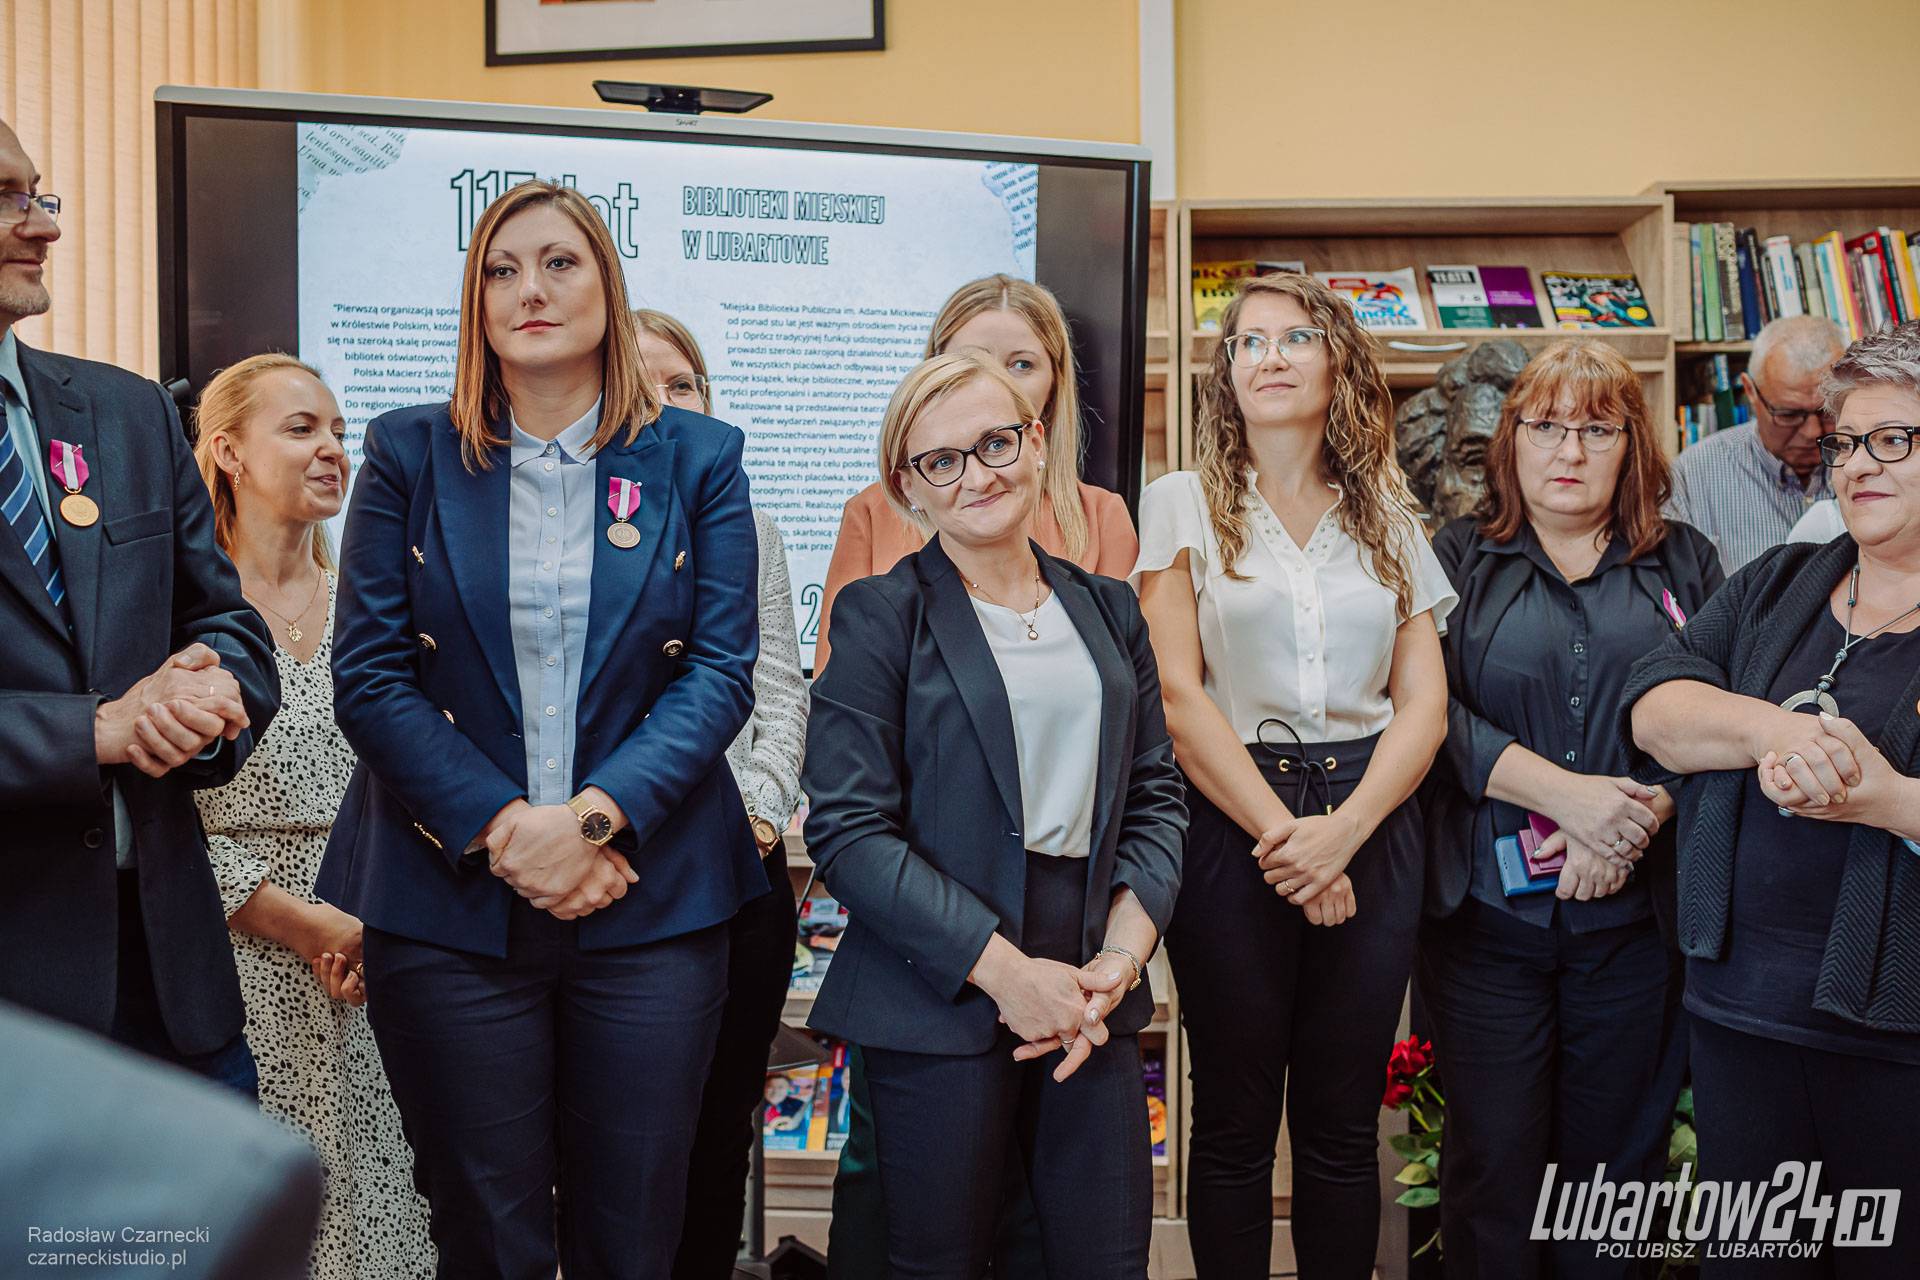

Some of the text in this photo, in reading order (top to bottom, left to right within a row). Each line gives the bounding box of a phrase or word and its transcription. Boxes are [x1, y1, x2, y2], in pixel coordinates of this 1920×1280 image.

[683, 186, 886, 225] BIBLIOTEKI MIEJSKIEJ
[682, 230, 829, 266] W LUBARTOWIE
[380, 305, 433, 317] organizacją
[435, 306, 460, 317] społe
[758, 303, 800, 313] Biblioteka
[802, 304, 841, 315] Publiczna
[859, 306, 888, 317] Adama
[341, 319, 390, 330] Królestwie
[728, 318, 739, 326] od
[741, 318, 769, 328] ponad
[771, 319, 784, 327] stu
[786, 319, 797, 327] lat
[799, 320, 813, 329] jest
[852, 320, 896, 331] ośrodkiem
[327, 336, 340, 346] się
[343, 337, 355, 345] na
[357, 337, 393, 347] szeroką
[422, 339, 458, 348] prowad
[743, 331, 774, 342] Oprócz
[345, 351, 385, 361] bibliotek
[894, 350, 925, 359] kultura
[730, 359, 744, 368] We
[747, 360, 791, 370] wszystkich
[353, 367, 384, 378] Polska
[386, 368, 422, 378] Macierz
[866, 378, 899, 388] wystaw
[344, 384, 386, 394] powstała
[388, 385, 421, 396] wiosną
[345, 399, 359, 409] Do
[729, 401, 781, 411] Realizowane
[751, 416, 775, 425] Wiele
[839, 431, 867, 442] wiedzy
[745, 445, 779, 453] izowane
[782, 446, 792, 455] są
[744, 458, 775, 467] ziałania
[777, 458, 786, 467] te
[758, 472, 803, 483] wszystkich
[847, 473, 869, 482] która
[781, 513, 816, 523] dorobku
[819, 514, 841, 523] kultu
[796, 542, 808, 551] tak
